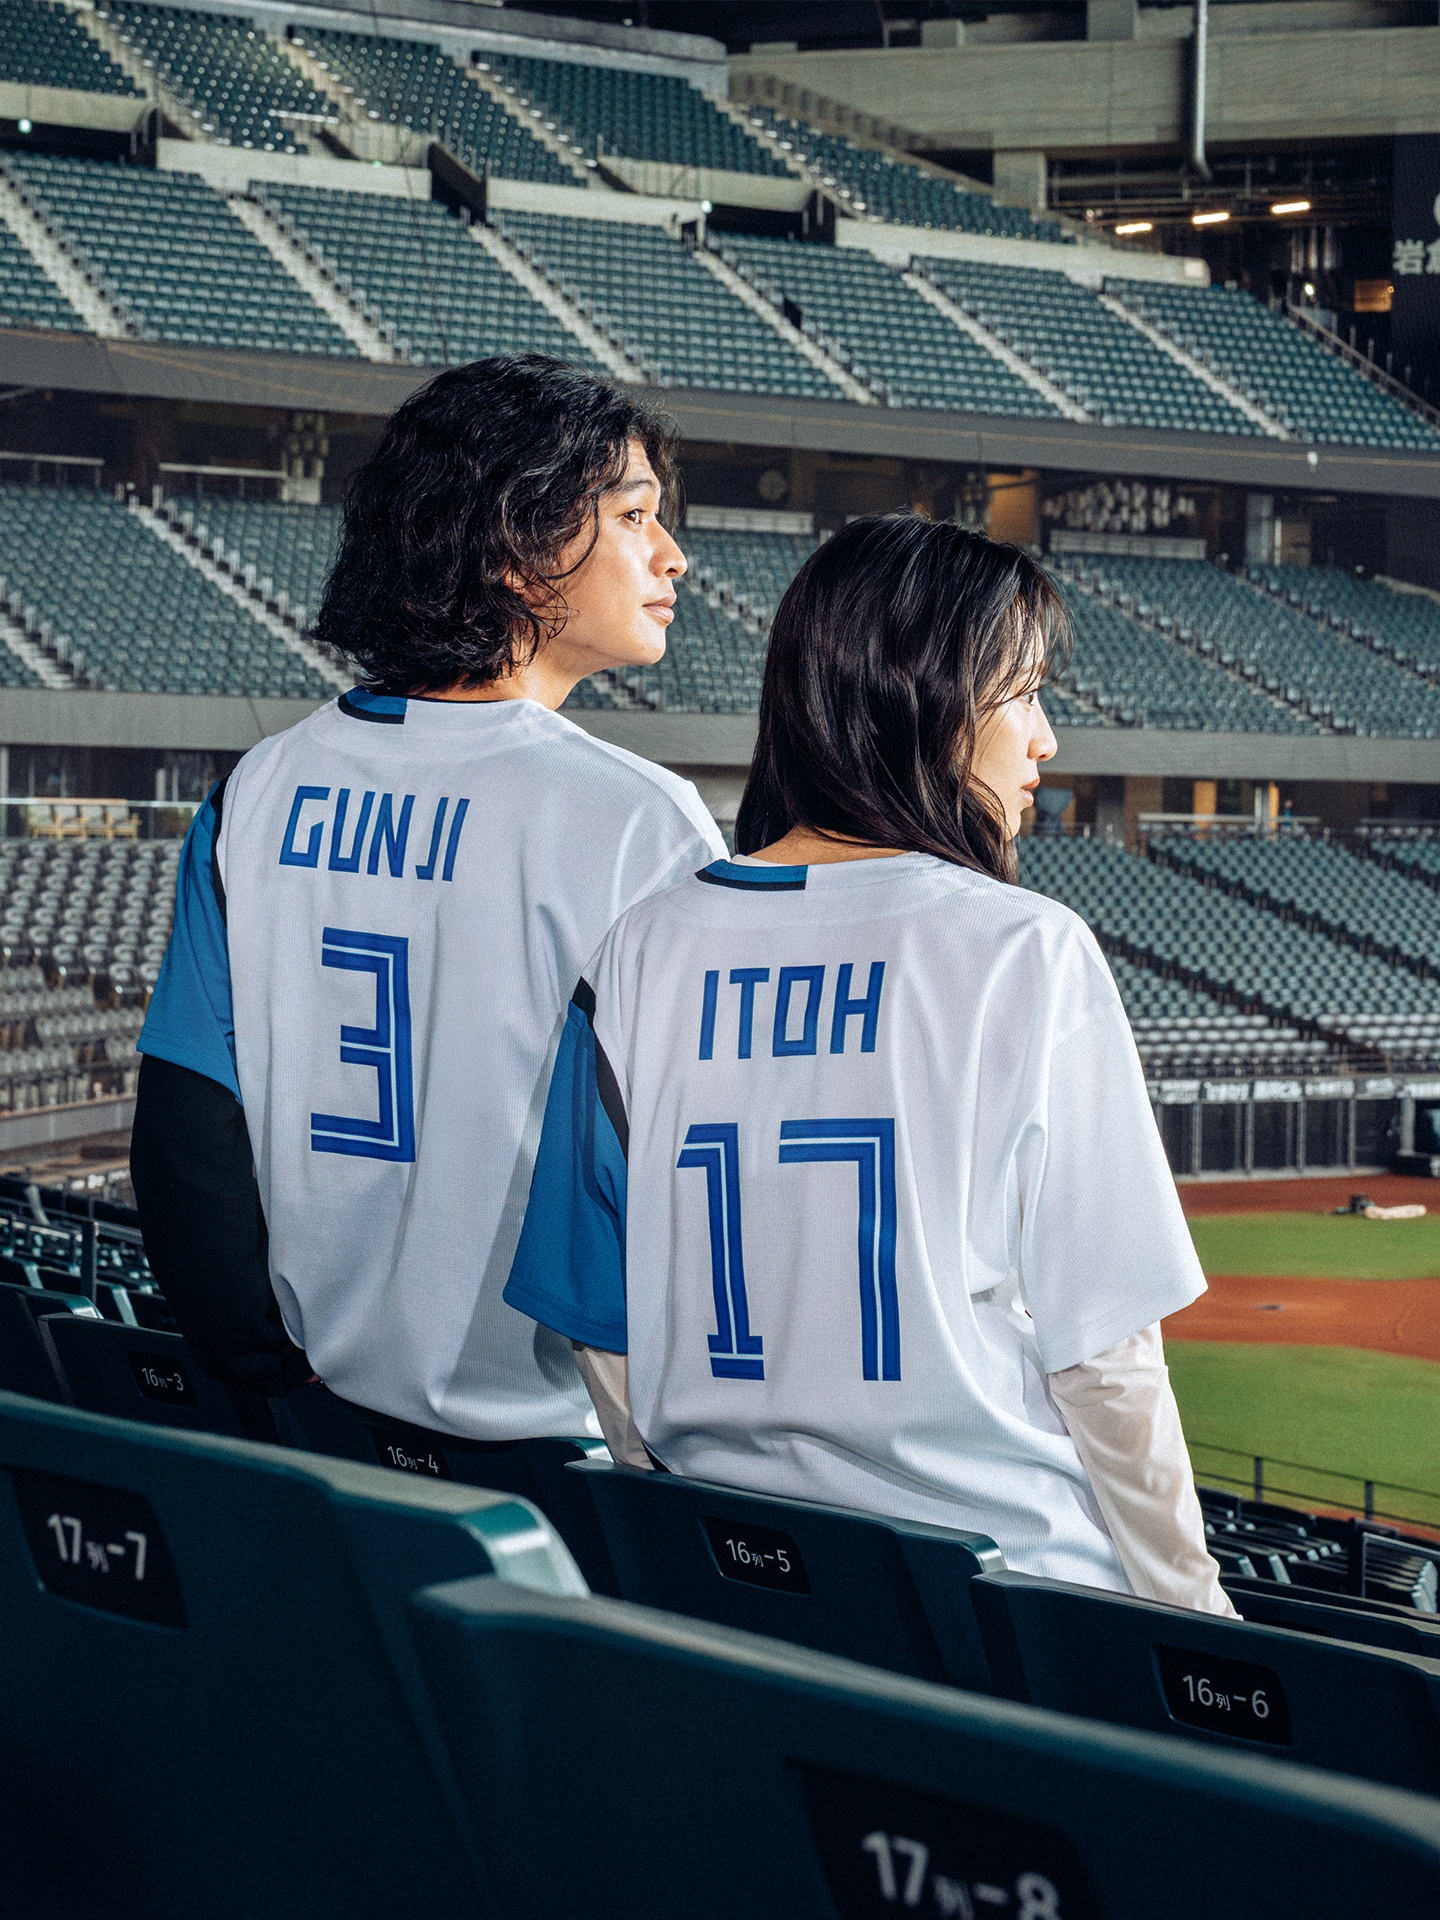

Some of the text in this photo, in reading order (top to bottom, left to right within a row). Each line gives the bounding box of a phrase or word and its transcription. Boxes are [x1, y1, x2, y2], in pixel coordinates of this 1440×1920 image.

[278, 785, 471, 882] GUNJI
[310, 926, 416, 1162] 3
[698, 961, 886, 1060] ITOH
[676, 1117, 902, 1382] 17
